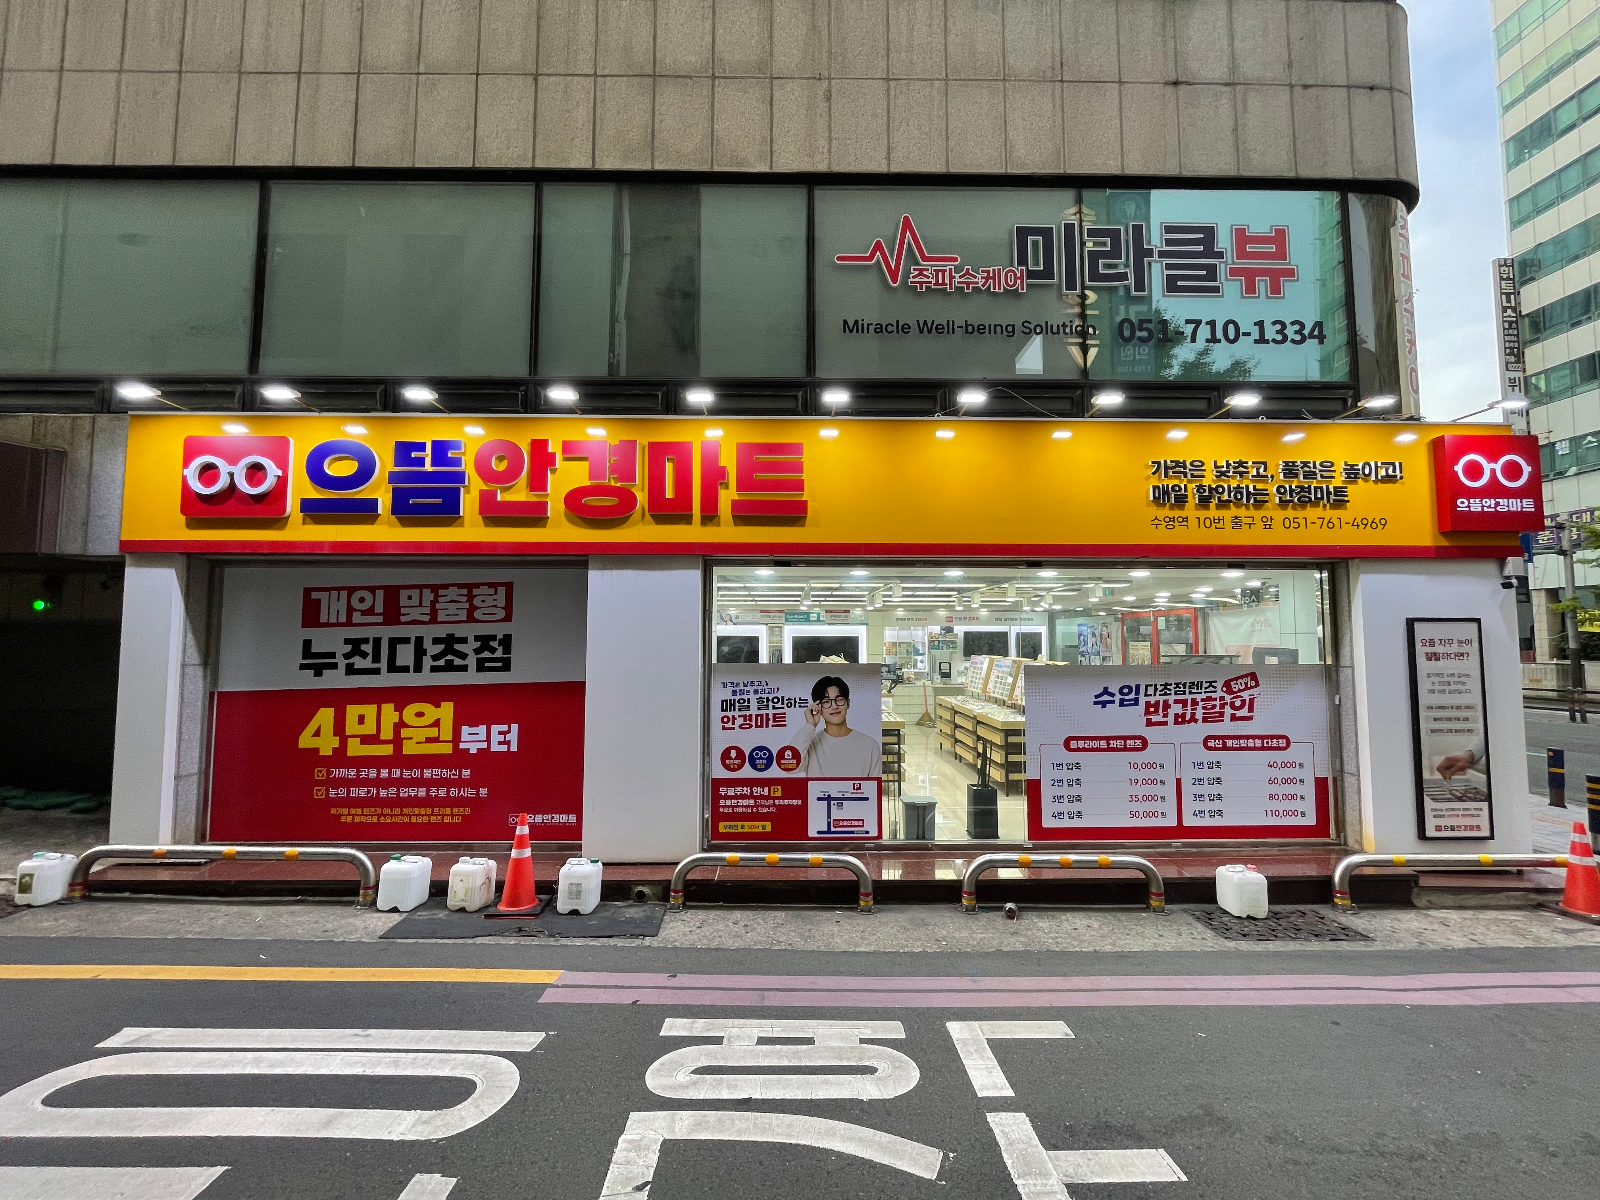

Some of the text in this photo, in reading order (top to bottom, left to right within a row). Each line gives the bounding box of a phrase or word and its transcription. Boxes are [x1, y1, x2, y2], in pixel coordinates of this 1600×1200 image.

[1014, 221, 1298, 298] 미라클뷰
[909, 267, 1027, 292] 주파수케어
[842, 319, 911, 335] Miracle
[1021, 320, 1097, 335] Solution
[1117, 318, 1326, 345] 051-710-1334
[300, 438, 807, 518] 으뜸안경마트
[1149, 460, 1404, 483] 가격은 낮추고, 품질은 높이고!
[1149, 484, 1350, 504] 매일 할인하는 안경마트
[1456, 498, 1535, 512] 으뜸안경마트
[1150, 516, 1387, 530] 수영역 10번 출구 앞 051-761-4969
[311, 585, 506, 624] 개인 맞춤형
[299, 633, 513, 677] 누진다초점
[1230, 676, 1256, 692] 50%
[1093, 680, 1218, 709] 수입 다초점렌즈
[721, 696, 809, 712] 매일 할인하는
[1144, 694, 1256, 727] 반값할인
[721, 712, 787, 731] 안경마트
[298, 702, 519, 756] 4만원 부터
[1070, 739, 1143, 749] 블루라이트 차단 렌즈
[1207, 738, 1286, 747] 국산 개인맞춤형 다초점
[1051, 762, 1064, 771] 1번
[1066, 762, 1082, 771] 압축
[1128, 762, 1158, 771] 10,000
[1191, 761, 1204, 770] 1번
[1206, 761, 1222, 770] 압축
[1267, 761, 1297, 770] 40,000
[329, 768, 471, 779] 가까운 곳을 볼 때 눈이 불편하신 분
[1050, 778, 1064, 787] 2번
[1066, 778, 1082, 787] 압축
[1129, 778, 1158, 787] 19,000
[1191, 777, 1205, 786] 2번
[1207, 777, 1223, 786] 압축
[1267, 777, 1298, 786] 60,000
[328, 787, 489, 798] 눈의 피로가 높은 업무를 주로 하시는 분
[719, 786, 751, 796] 무료주차
[752, 786, 769, 796] 안내
[1192, 793, 1205, 802] 3번
[1207, 793, 1223, 802] 압축
[1268, 793, 1298, 802] 80,000
[1051, 794, 1065, 804] 3번
[1067, 794, 1083, 804] 압축
[1128, 794, 1159, 804] 35,000
[527, 813, 577, 823] 으뜸안경마트
[1051, 810, 1065, 820] 4번
[1067, 810, 1083, 820] 압축
[1129, 810, 1160, 820] 50,000
[1192, 809, 1206, 818] 4번
[1207, 809, 1224, 818] 압축
[1264, 809, 1299, 818] 110,000
